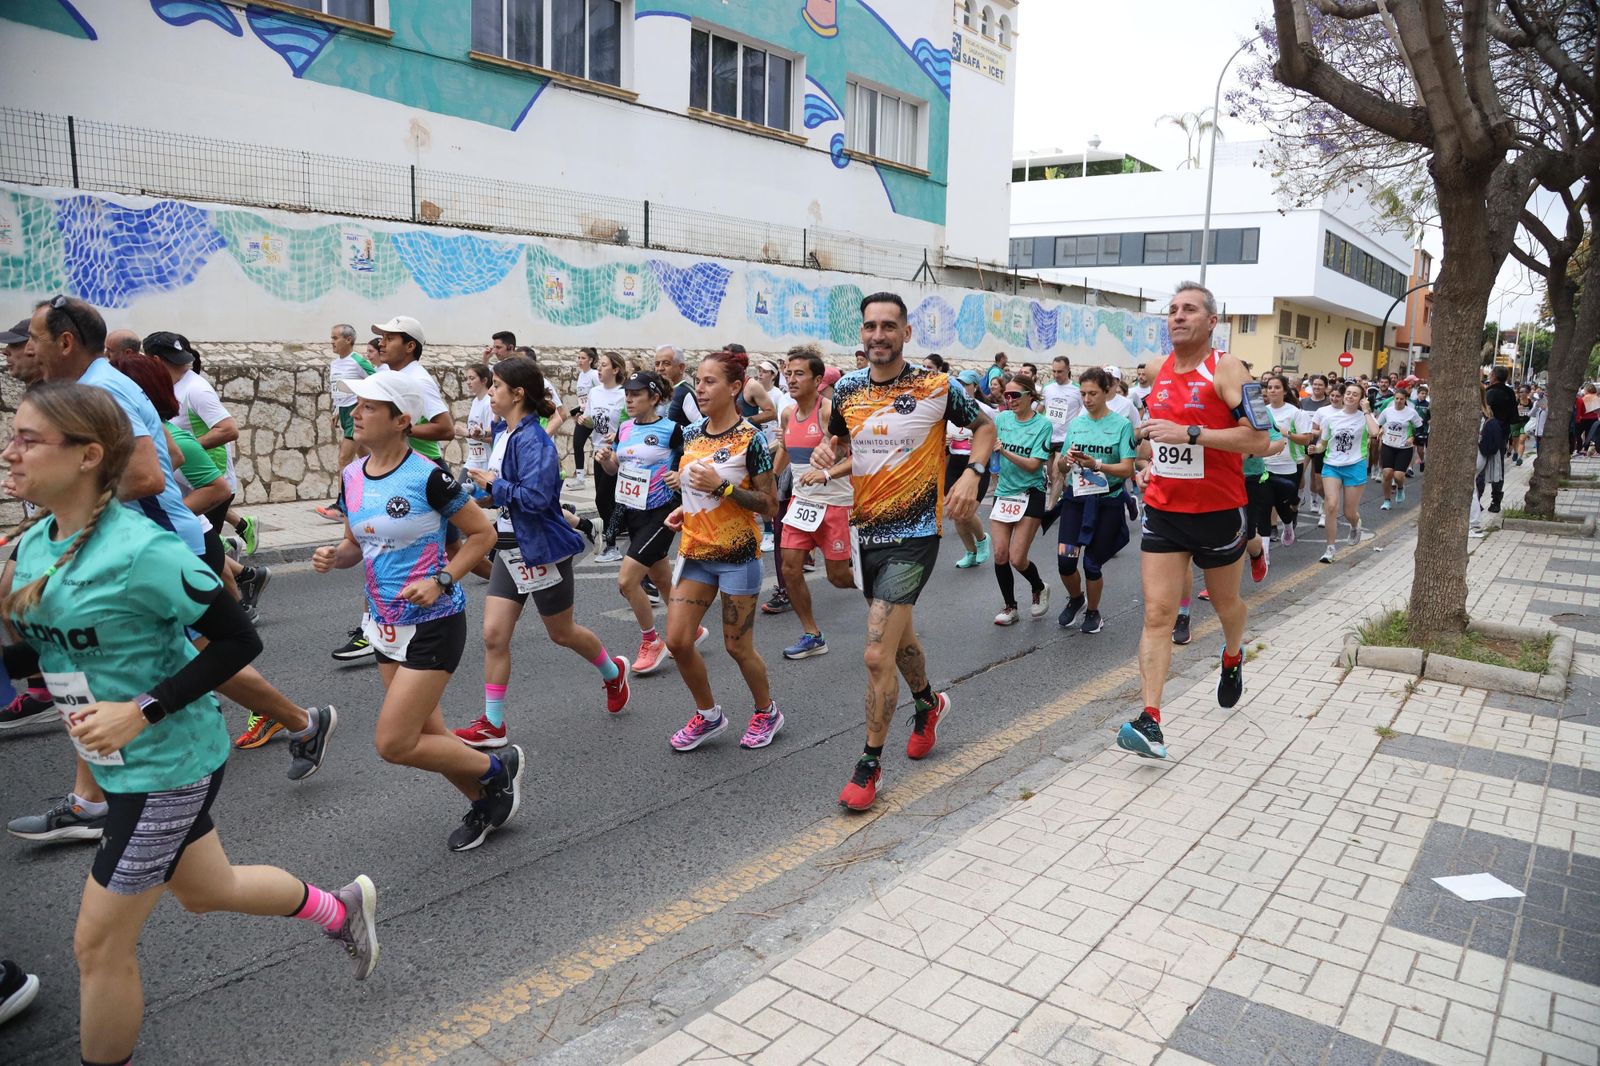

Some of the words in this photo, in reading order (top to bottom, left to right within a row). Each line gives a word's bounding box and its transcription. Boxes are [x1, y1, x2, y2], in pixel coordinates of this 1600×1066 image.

[962, 53, 980, 70] SAFA
[988, 65, 1004, 80] ICET
[1050, 410, 1063, 418] 838
[1158, 446, 1193, 465] 894
[619, 480, 641, 498] 154
[794, 508, 818, 523] 503
[1000, 503, 1021, 515] 348
